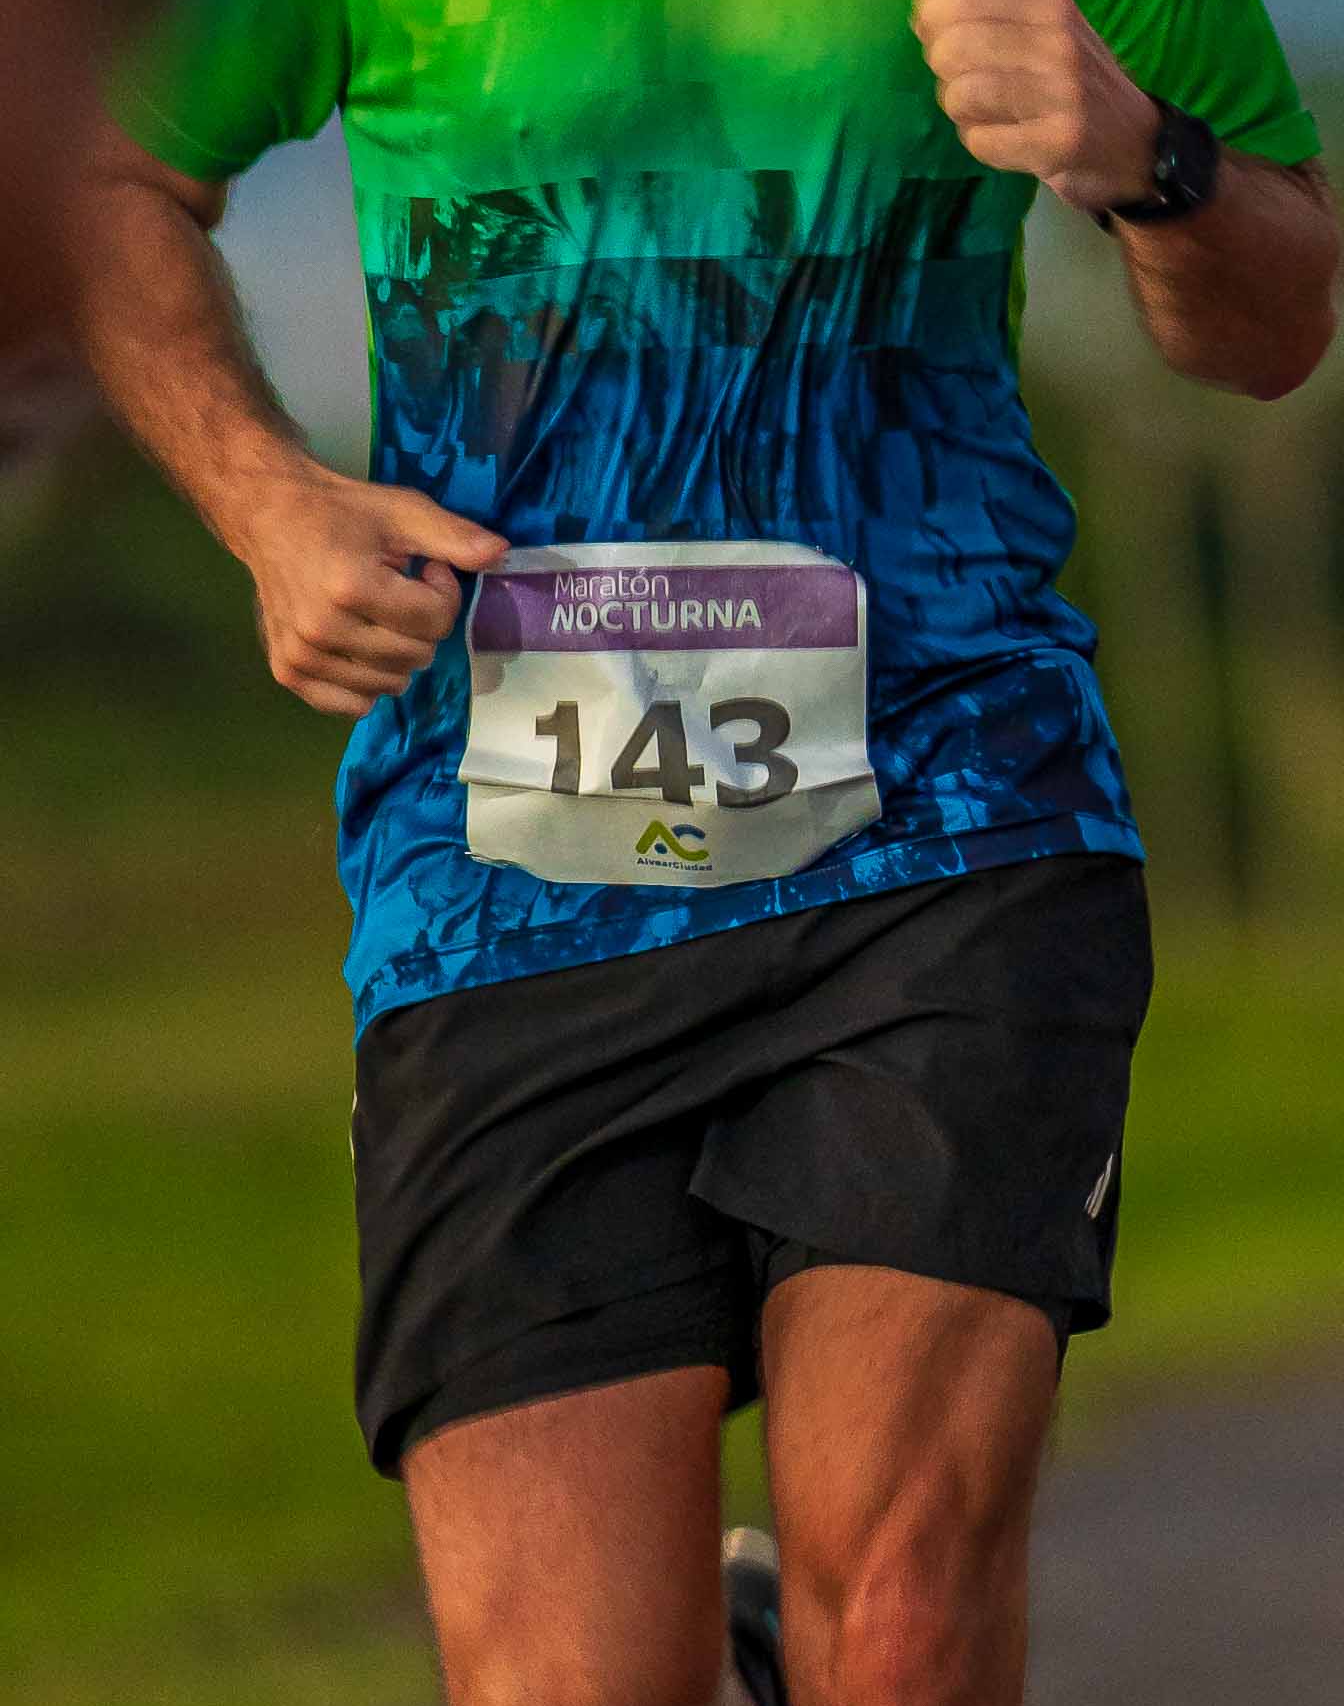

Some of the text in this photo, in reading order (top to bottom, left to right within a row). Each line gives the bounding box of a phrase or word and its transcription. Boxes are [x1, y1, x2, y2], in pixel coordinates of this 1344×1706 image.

[555, 566, 670, 599] Maratón
[551, 598, 763, 632] NOCTURNA
[536, 697, 798, 808] 143
